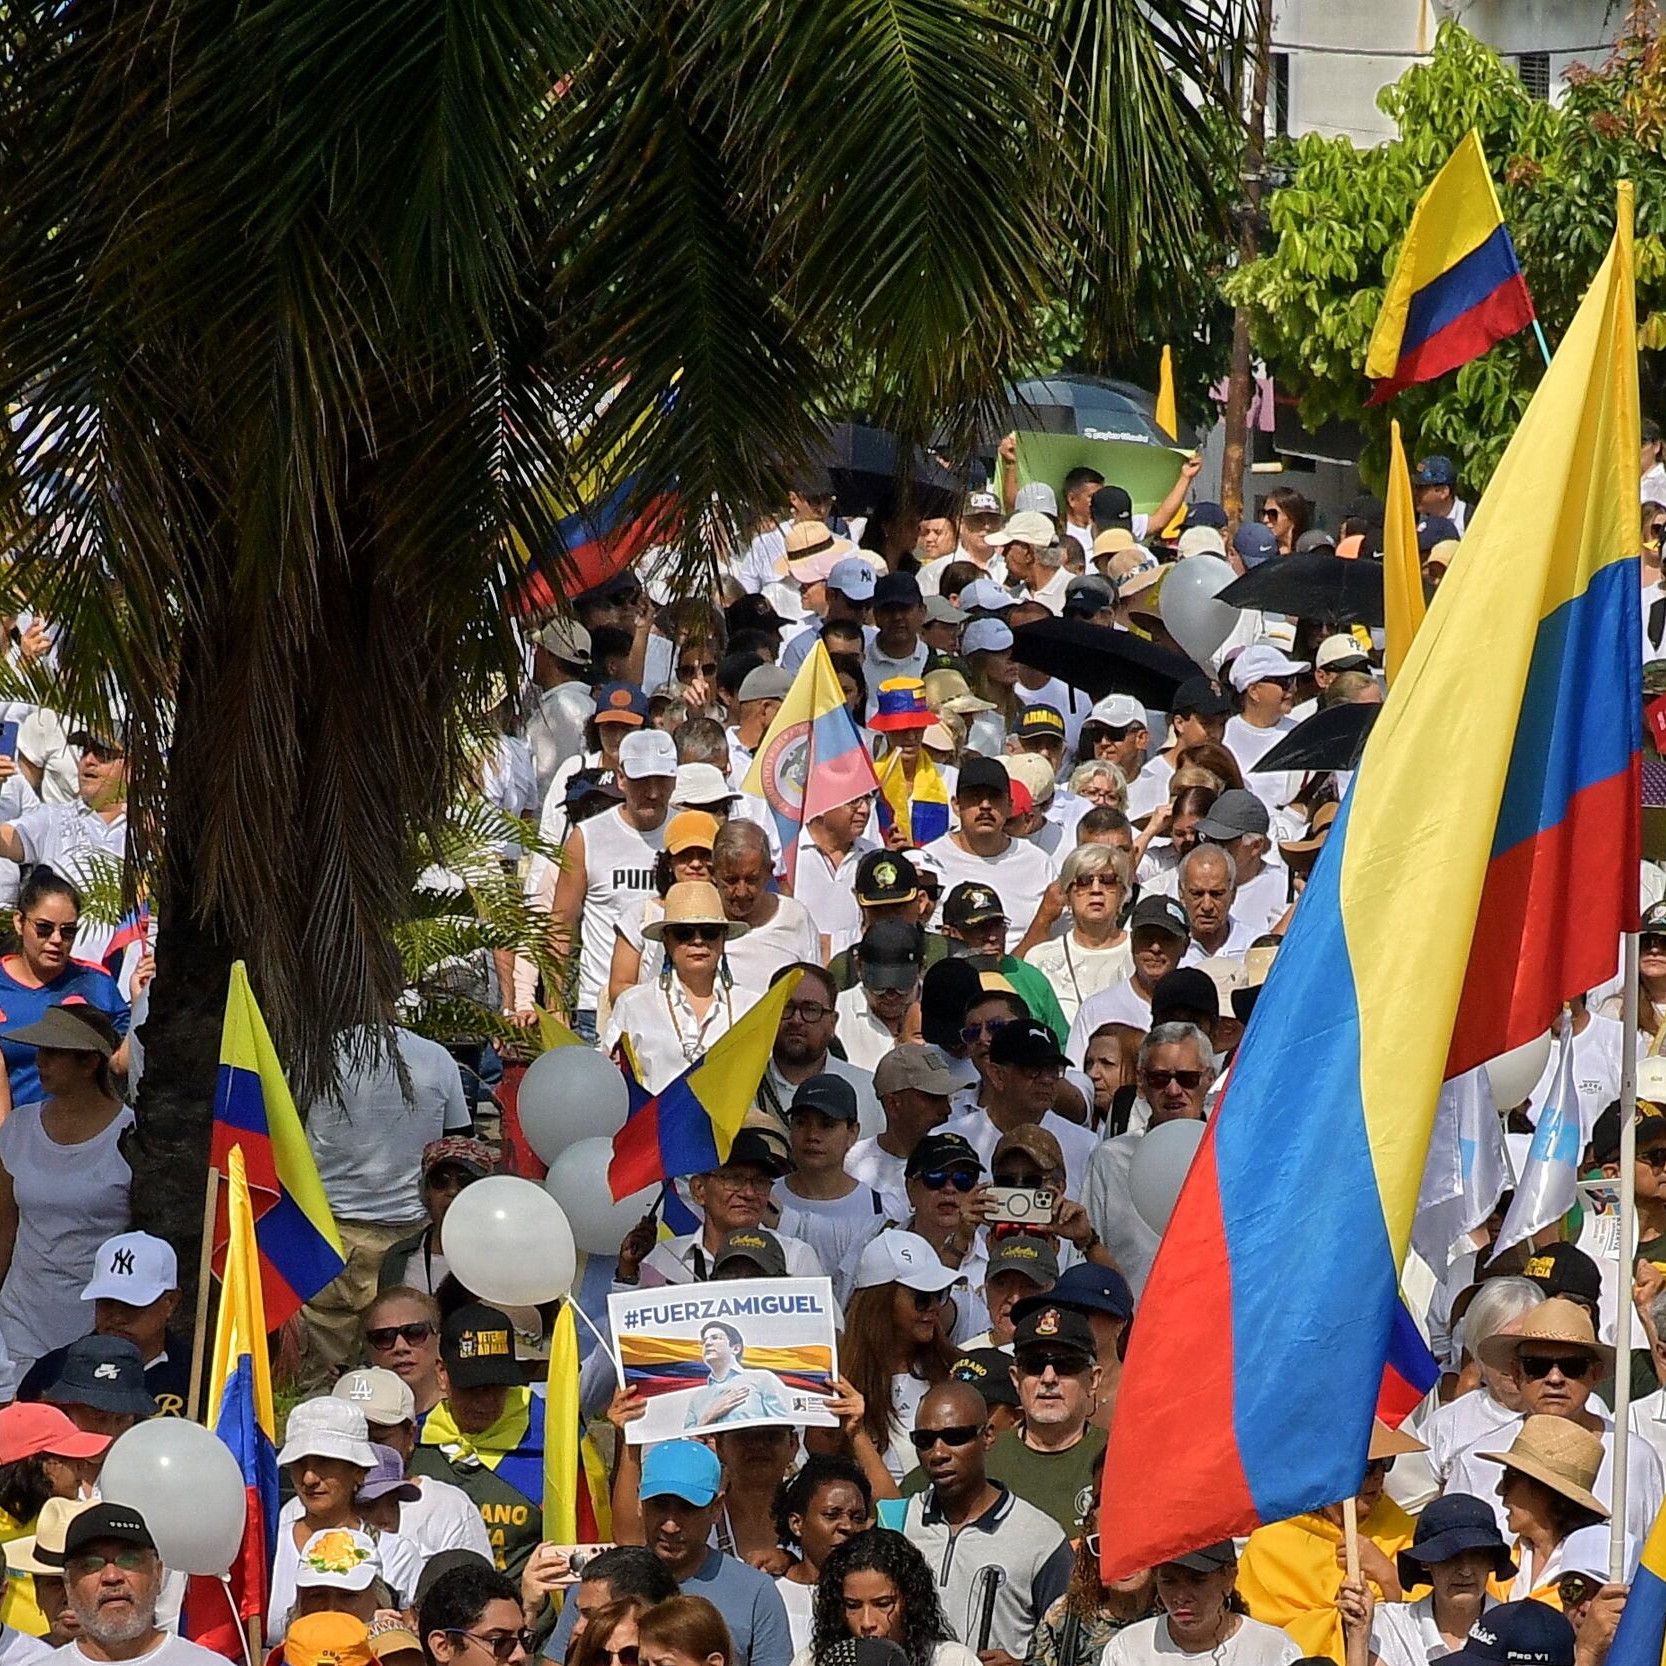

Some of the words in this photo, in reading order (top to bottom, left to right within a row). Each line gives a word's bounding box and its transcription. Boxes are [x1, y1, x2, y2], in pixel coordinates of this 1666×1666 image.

[1023, 709, 1064, 729] ARMADA
[110, 1248, 136, 1276] NY
[623, 1296, 824, 1330] #FUERZAMIGUEL
[350, 1374, 373, 1400] LA
[1529, 1651, 1549, 1661] V1
